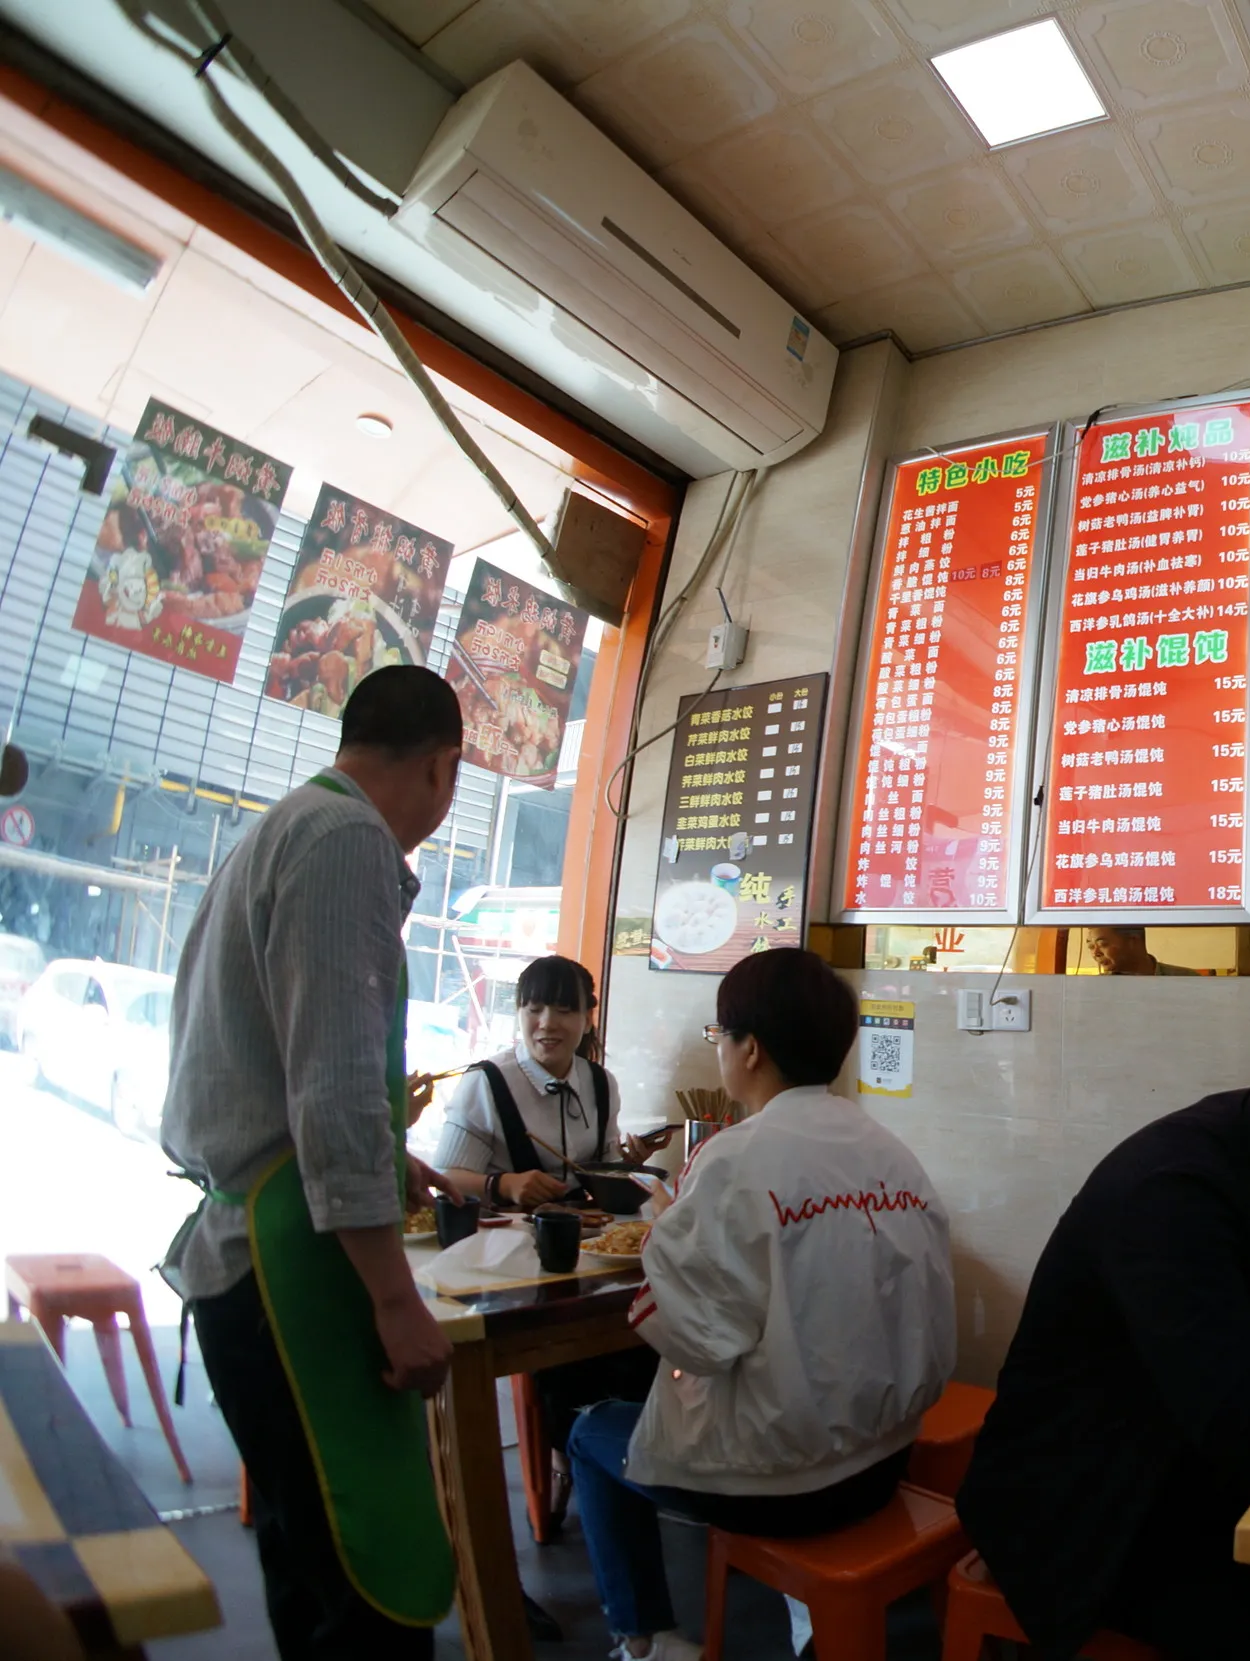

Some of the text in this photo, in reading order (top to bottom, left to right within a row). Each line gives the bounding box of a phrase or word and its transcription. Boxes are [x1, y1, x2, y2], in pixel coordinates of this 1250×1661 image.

[1100, 418, 1234, 463] 滋补炖品
[916, 450, 1031, 496] 特色小吃
[1221, 472, 1250, 485] 10元
[1016, 485, 1034, 497] 5元
[1014, 499, 1032, 511] 5元
[1220, 497, 1250, 510] 10元
[1012, 514, 1030, 526] 6元
[1010, 528, 1029, 540] 6元
[1220, 522, 1250, 536] 10元
[1008, 543, 1027, 555] 6元
[1218, 548, 1249, 562] 10元
[1005, 573, 1024, 585] 8元
[1218, 575, 1248, 588] 10元
[1003, 588, 1022, 600] 6元
[1001, 603, 1020, 616] 6元
[1217, 602, 1247, 616] 14元
[1083, 630, 1228, 675] 滋补馄饨
[1065, 675, 1245, 702] 清凉排骨汤馄饨 15元
[1063, 708, 1244, 735] 党参猪心汤馄饨 15元
[684, 748, 749, 768] 白菜鲜肉水饺
[1061, 742, 1243, 767] 树菇老鸭汤馄饨 15元
[1059, 777, 1242, 800] 莲子猪肚汤馄饨 15元
[1058, 812, 1242, 834] 当归牛肉汤馄饨 15元
[1056, 848, 1241, 868] 花旗参乌鸡汤馄饨 15元
[739, 871, 772, 904] 纯
[1054, 885, 1240, 902] 西洋参乳鸽汤馄饨 18元
